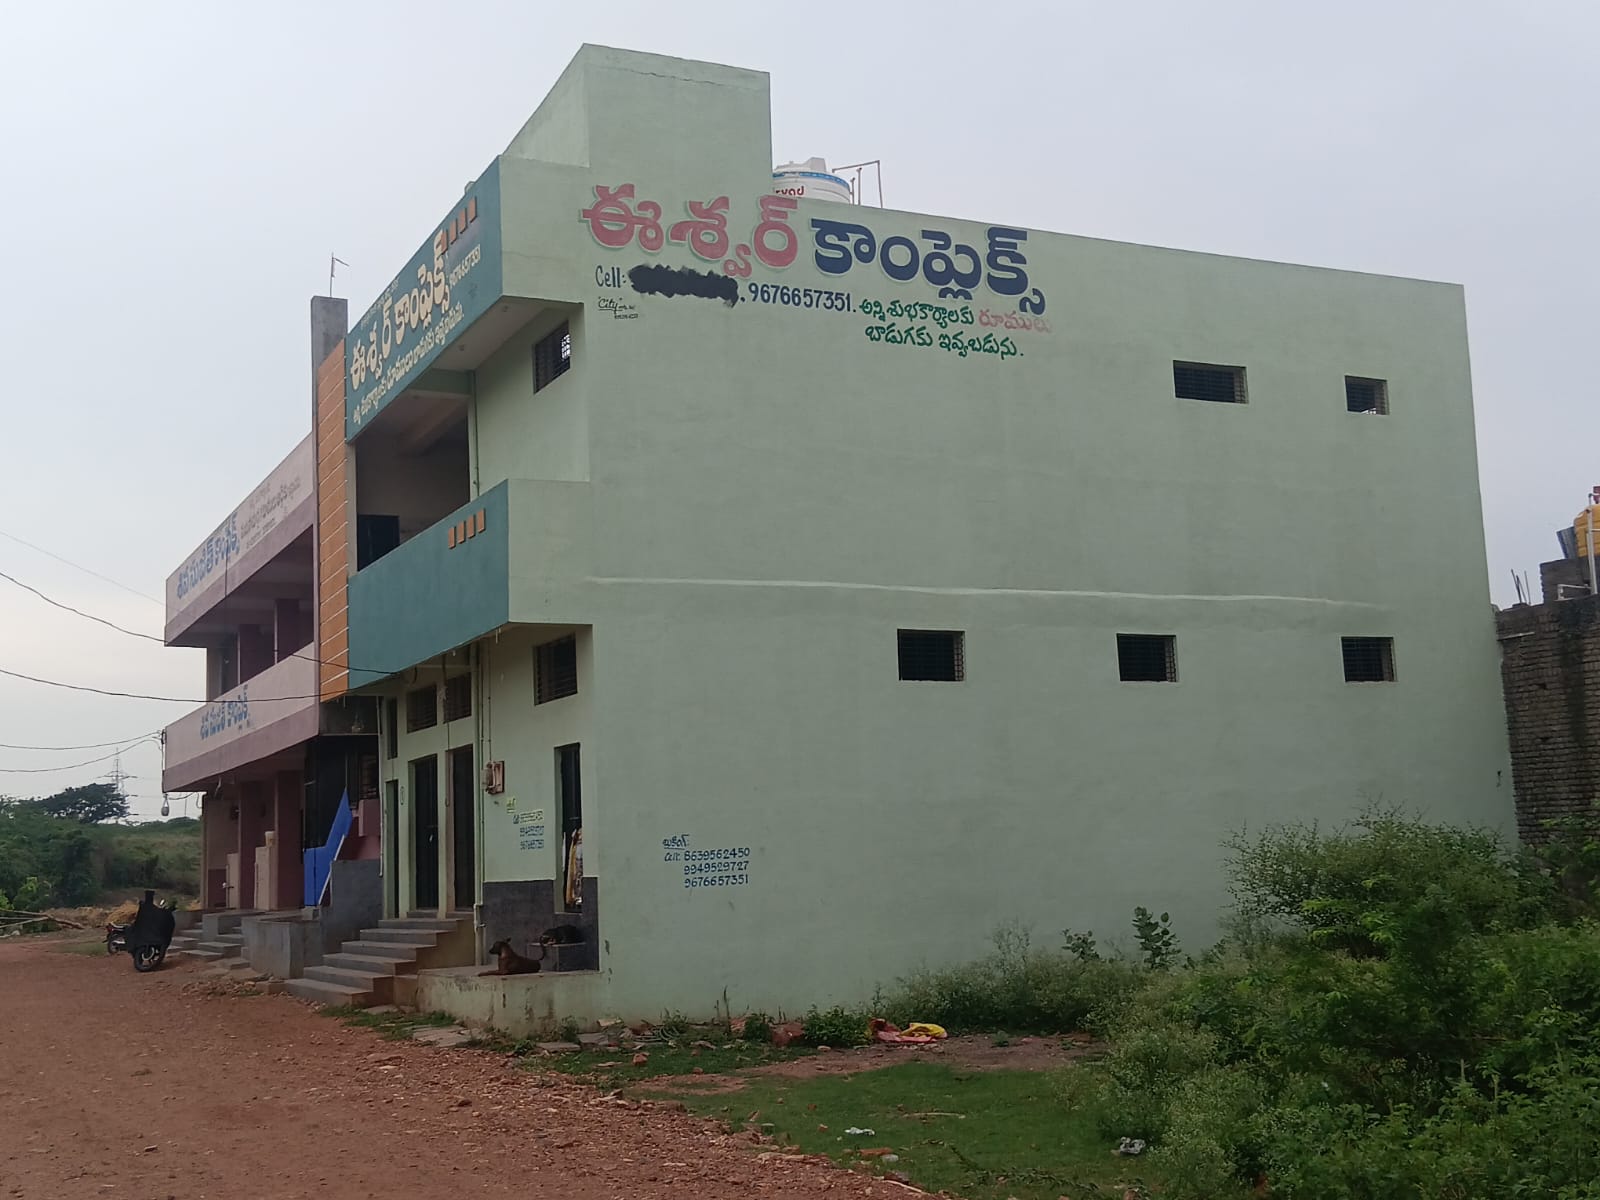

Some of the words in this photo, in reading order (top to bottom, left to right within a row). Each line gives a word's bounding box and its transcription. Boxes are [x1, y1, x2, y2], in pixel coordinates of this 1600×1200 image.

[581, 182, 799, 279] ఈశ్వర్
[810, 217, 1047, 315] కాంప్లెక్స్
[595, 265, 627, 289] Cell:
[350, 296, 392, 390] ఈశ్వర్
[865, 322, 934, 347] బాడుగకు
[684, 847, 750, 861] 8639562450
[684, 861, 749, 875] 9949529727
[684, 874, 749, 888] 9676657351
